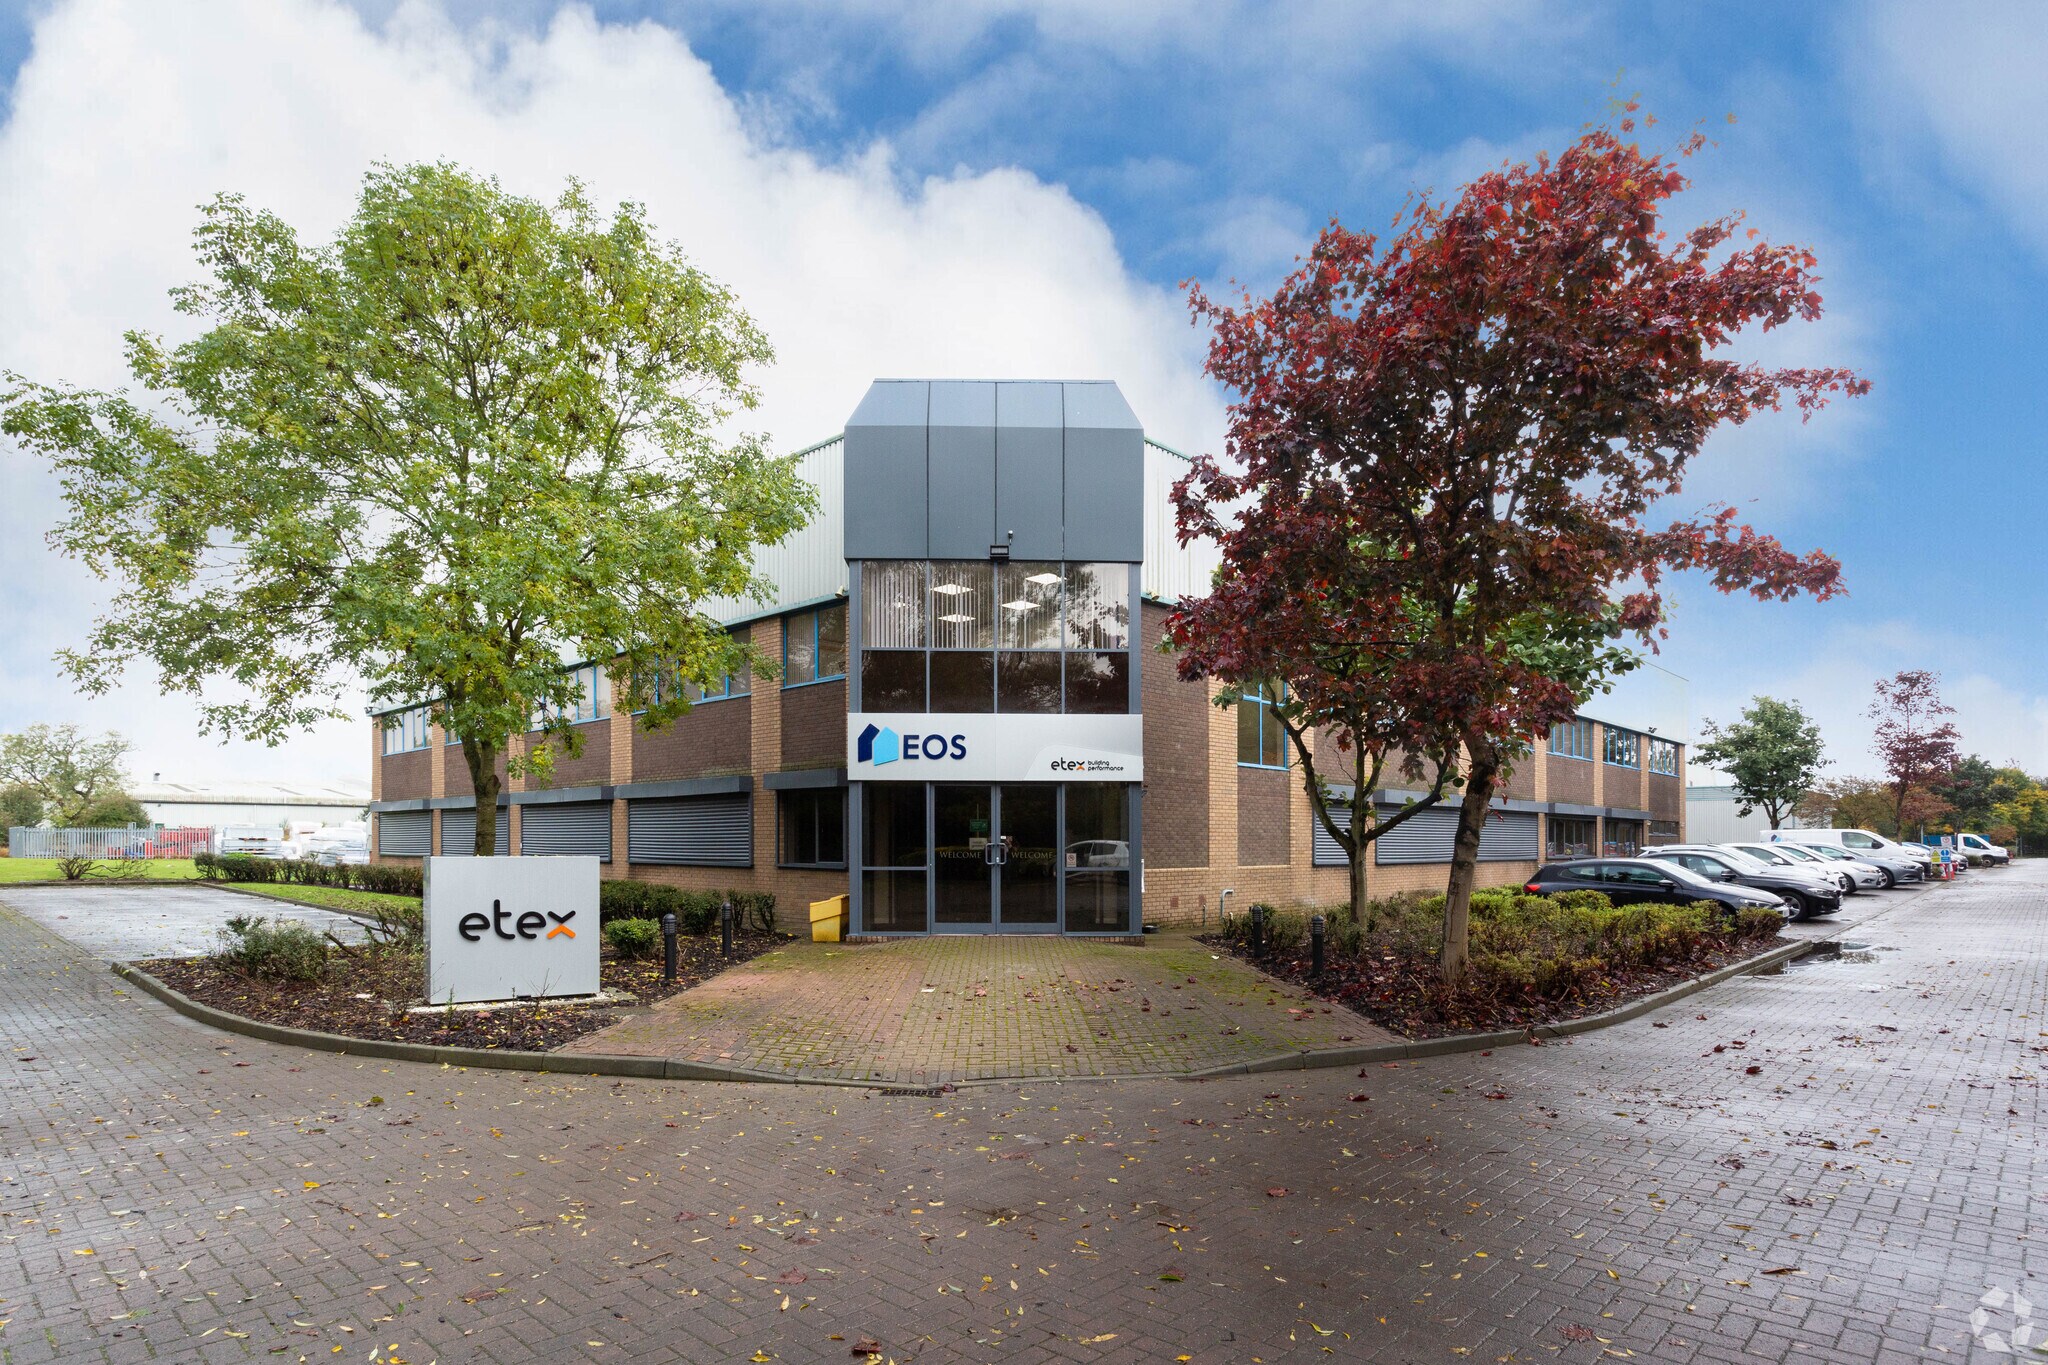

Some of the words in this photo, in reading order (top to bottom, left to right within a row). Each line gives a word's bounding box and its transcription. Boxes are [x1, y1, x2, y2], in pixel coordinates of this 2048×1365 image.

[903, 734, 967, 760] EOS
[1051, 757, 1085, 771] etex
[940, 851, 981, 859] WELCOME
[1011, 851, 1053, 859] WELCOME
[458, 899, 576, 941] etex
